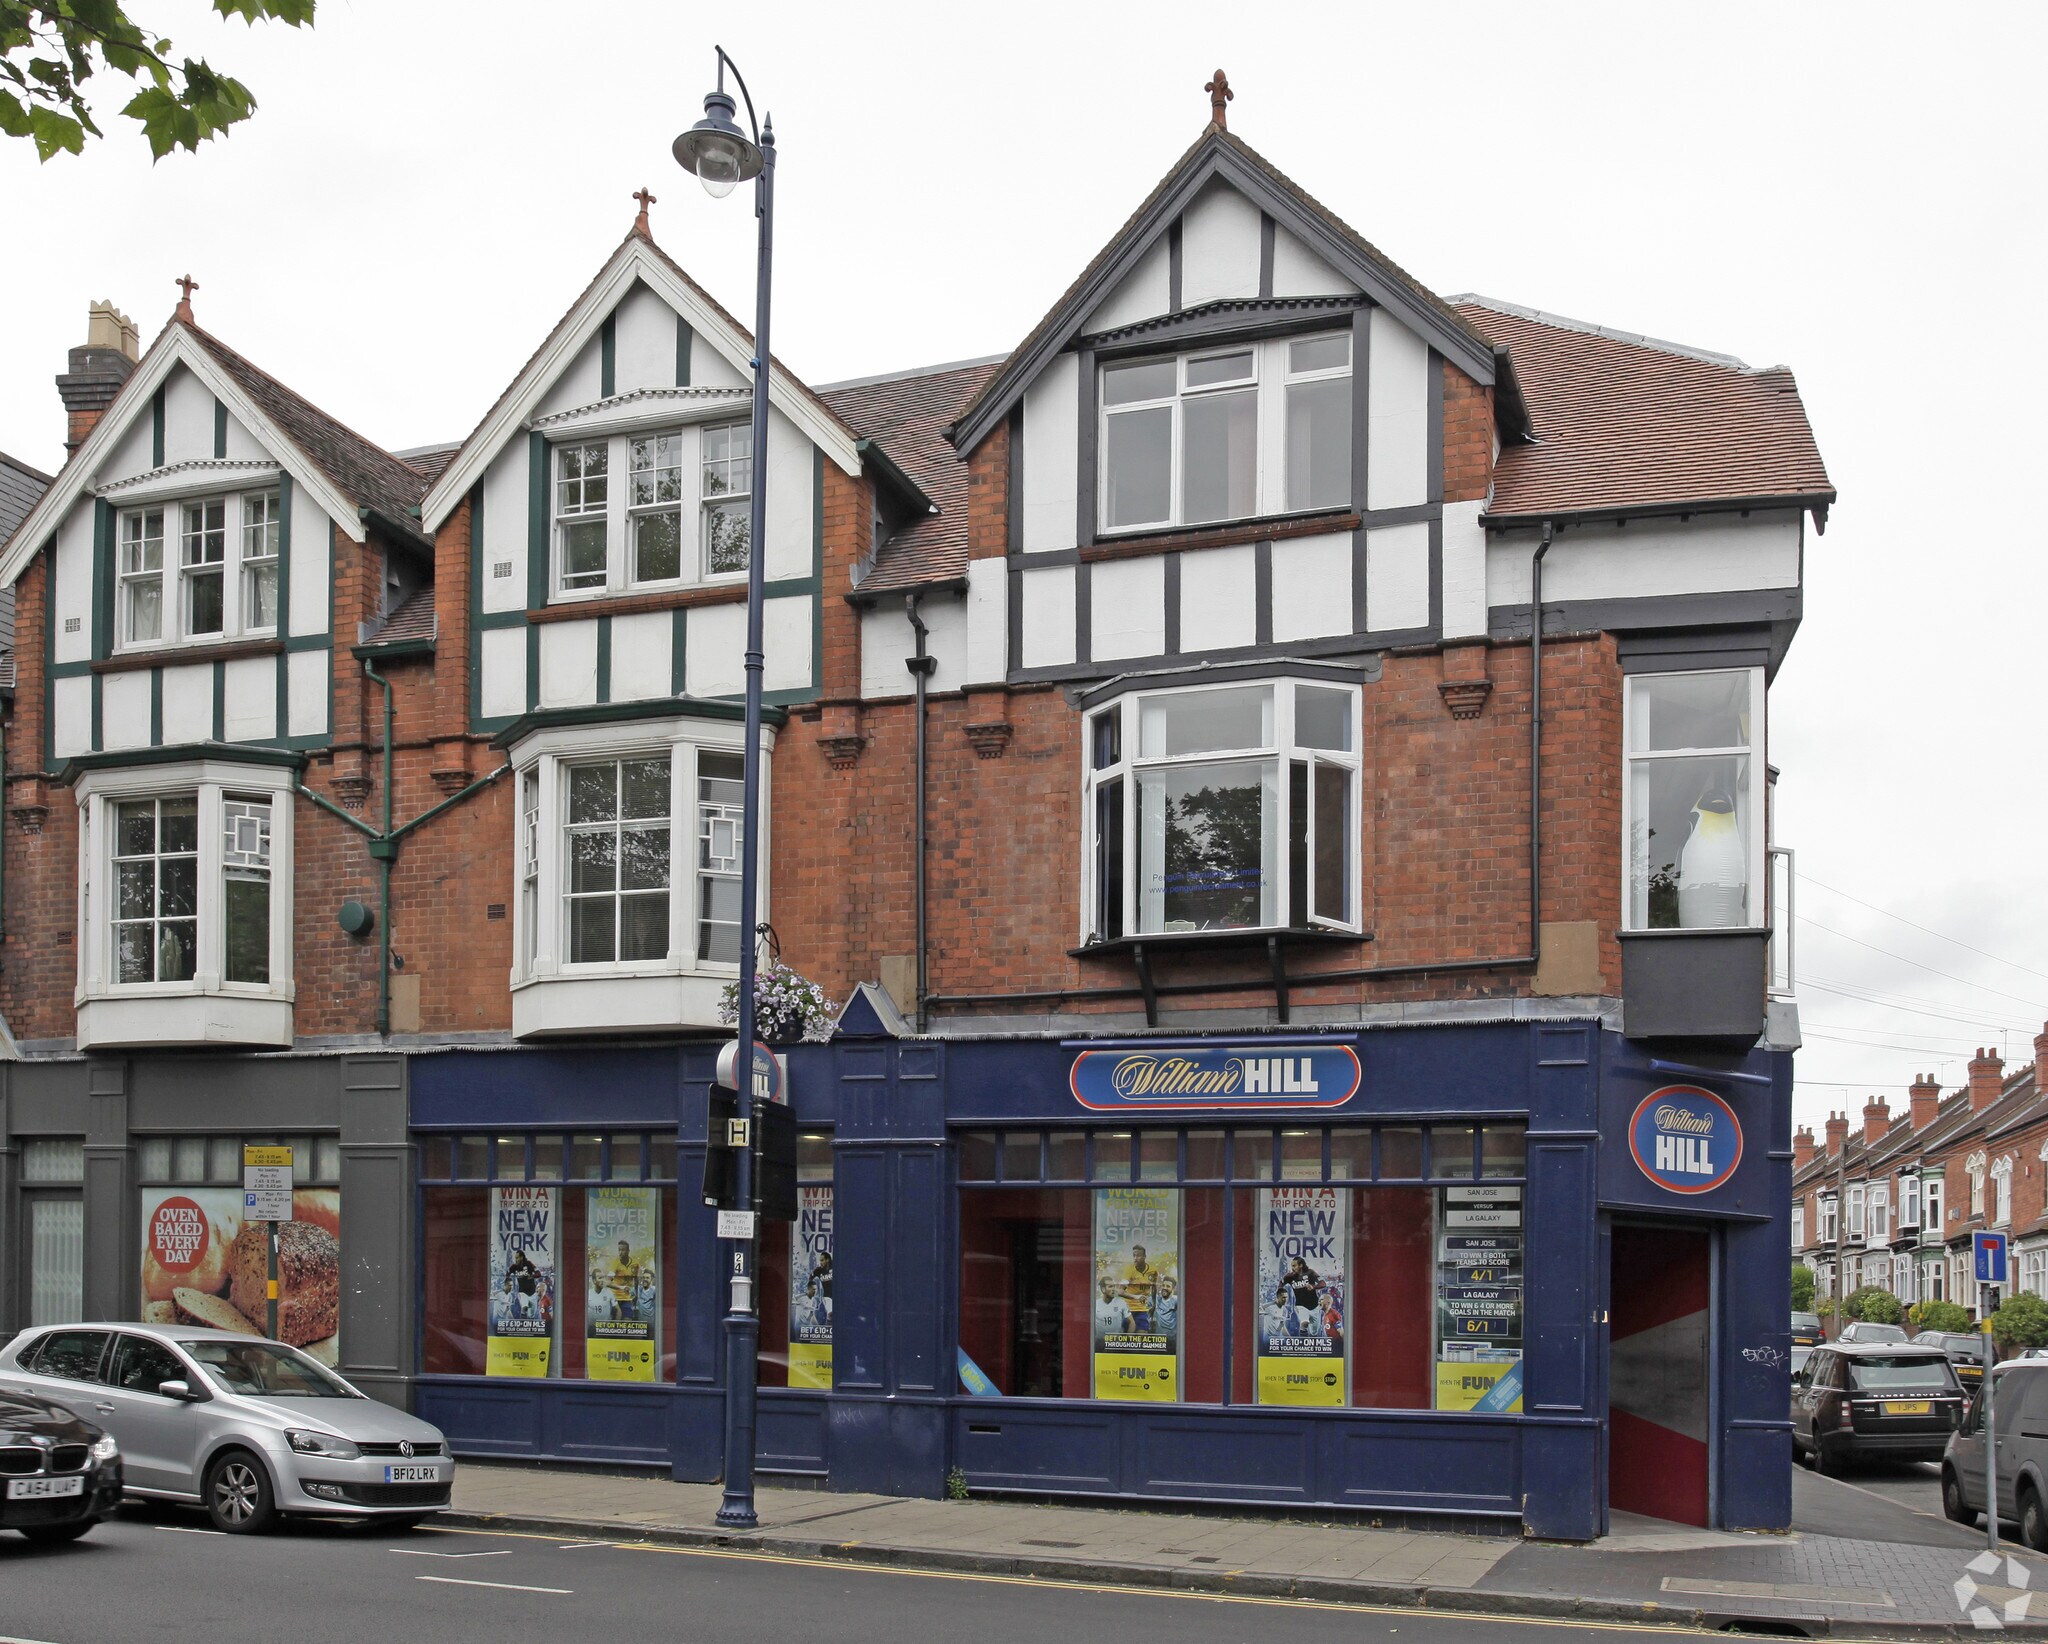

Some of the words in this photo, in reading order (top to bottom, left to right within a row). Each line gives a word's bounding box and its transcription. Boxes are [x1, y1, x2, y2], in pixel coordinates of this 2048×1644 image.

[1153, 873, 1183, 882] Penguin
[1112, 1055, 1244, 1096] William
[1245, 1058, 1318, 1093] HILL
[752, 1074, 770, 1098] ILL
[1655, 1105, 1713, 1134] William
[732, 1122, 745, 1143] H
[1656, 1135, 1713, 1174] HILL
[501, 1187, 531, 1199] WIN
[536, 1187, 548, 1199] A
[1108, 1189, 1169, 1198] WORLD
[1272, 1188, 1313, 1198] WIN
[1319, 1188, 1335, 1198] A
[248, 1195, 254, 1205] P
[1106, 1199, 1168, 1209] FOOTBALL
[1270, 1200, 1290, 1208] TRIP
[1294, 1200, 1311, 1208] FOR
[1315, 1200, 1320, 1208] 2
[1324, 1200, 1335, 1208] TO
[160, 1209, 198, 1221] OVEN
[499, 1210, 548, 1231] NEW
[597, 1209, 647, 1223] NEVER
[802, 1210, 832, 1232] NE
[1106, 1210, 1167, 1226] NEVER
[155, 1222, 203, 1235] BAKED
[1270, 1211, 1336, 1235] NEW
[596, 1224, 647, 1238] STOPS
[1106, 1227, 1168, 1243] STOPS
[157, 1236, 201, 1249] EVERY
[499, 1233, 548, 1251] YORK
[1270, 1237, 1335, 1258] YORK
[165, 1250, 192, 1263] DAY
[1471, 1270, 1492, 1281] 4/1
[1104, 1317, 1112, 1325] 18
[1467, 1321, 1489, 1332] 6/1
[512, 1352, 529, 1360] FUN
[608, 1352, 630, 1362] FUN
[1119, 1367, 1146, 1379] FUN
[1287, 1375, 1308, 1384] FUN
[1462, 1376, 1495, 1390] FUN
[394, 1468, 414, 1479] BF12
[418, 1468, 434, 1479] LRX
